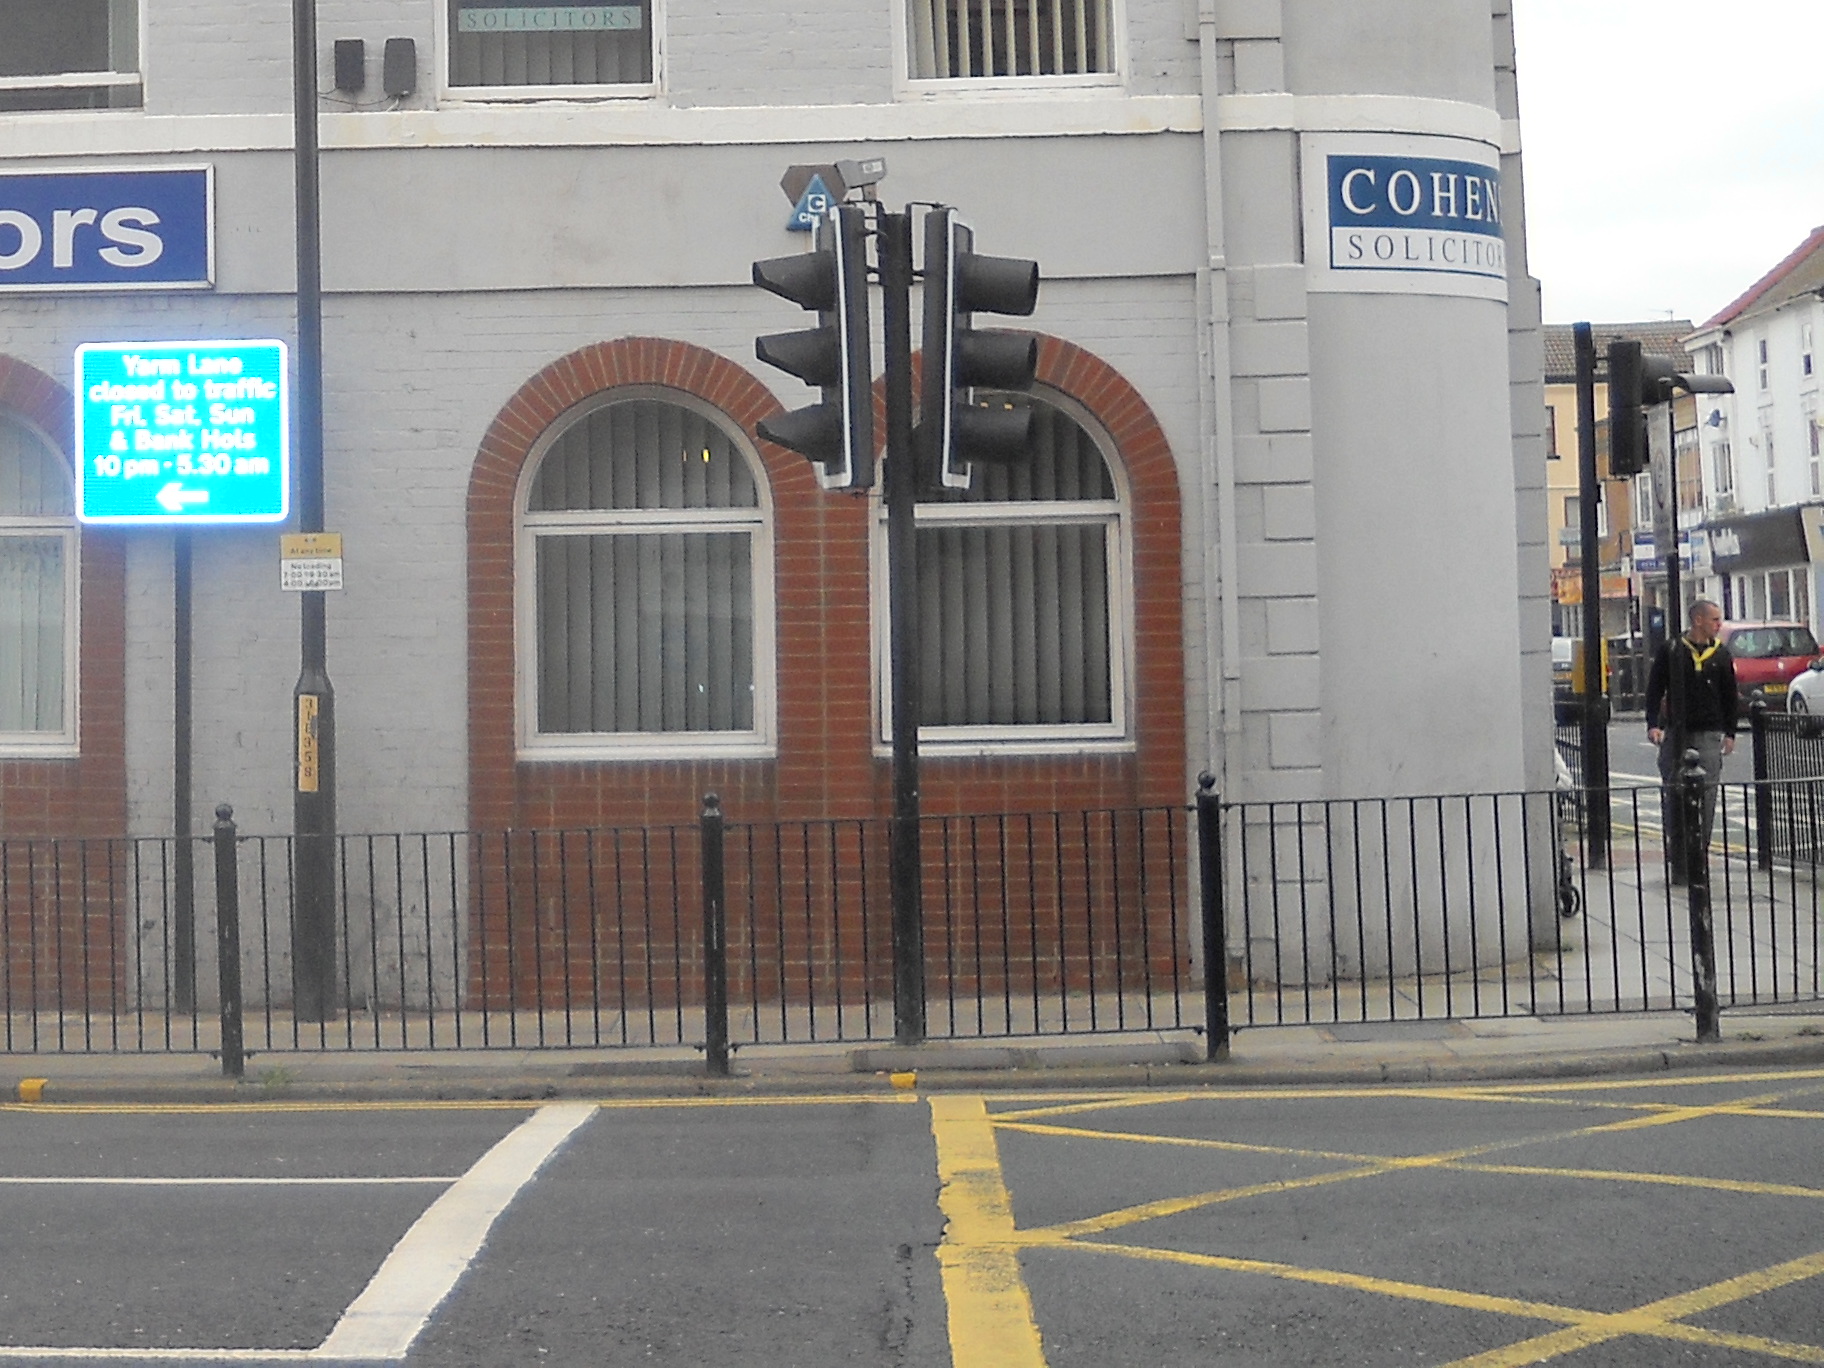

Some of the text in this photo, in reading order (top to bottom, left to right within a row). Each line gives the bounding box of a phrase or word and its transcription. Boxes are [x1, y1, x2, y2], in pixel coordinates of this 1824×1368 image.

[466, 10, 633, 29] SOLICITORS
[123, 353, 243, 376] Yarm Lane
[89, 377, 277, 401] closed to traffic
[209, 403, 255, 424] Sun
[110, 428, 257, 451] & Bank Hols
[94, 454, 121, 476] 10
[124, 459, 159, 479] pm
[177, 453, 232, 475] 5.30
[234, 457, 269, 474] am
